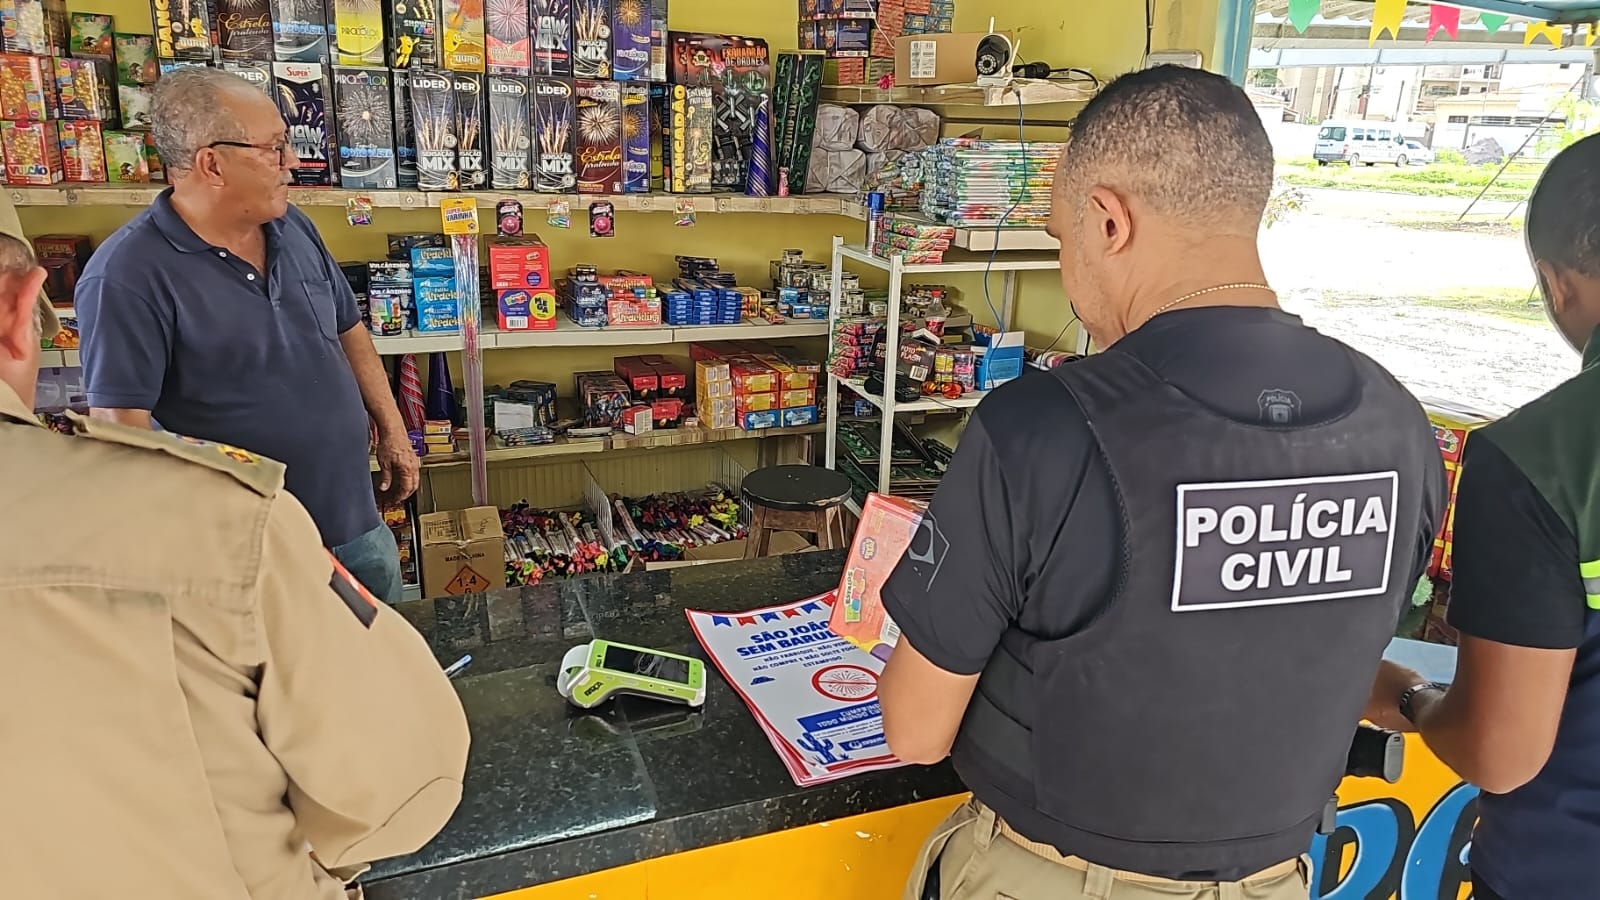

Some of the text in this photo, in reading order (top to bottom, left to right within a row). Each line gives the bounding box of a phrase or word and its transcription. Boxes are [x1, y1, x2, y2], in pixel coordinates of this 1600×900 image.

[219, 13, 271, 30] Estrela
[577, 46, 608, 60] MIX
[722, 47, 767, 59] ESQUADRÃO
[725, 57, 765, 67] DE DRONES
[286, 66, 310, 77] SUPER
[334, 71, 387, 86] PIROCOLOR
[412, 79, 446, 89] LIDER
[491, 84, 522, 94] LIDER
[536, 86, 568, 95] LIDER
[671, 84, 686, 192] PANCADÃO
[577, 146, 621, 164] Estrela
[421, 156, 456, 171] MIX
[496, 157, 529, 171] MIX
[542, 160, 573, 173] MIX
[445, 211, 473, 222] VARINHA
[534, 296, 549, 314] MEGA
[900, 351, 922, 362] FLASH
[1266, 394, 1291, 404] POLÍCIA
[1185, 493, 1388, 547] POLÍCIA
[1221, 546, 1352, 592] CIVIL
[457, 574, 477, 587] 1.4
[845, 570, 854, 605] ESTALOS
[750, 620, 830, 644] SÃO JOÃO
[736, 630, 840, 657] SEM BARUL
[780, 648, 818, 658] FABRIQUE,
[818, 643, 832, 651] NÃO
[752, 664, 768, 672] NÃO
[769, 659, 798, 669] COMPRE
[804, 653, 820, 661] NÃO
[821, 649, 841, 657] SOLTE
[803, 656, 846, 668] ESTAMPIDO.
[816, 718, 839, 728] TODO
[838, 711, 869, 722] MUNDO
